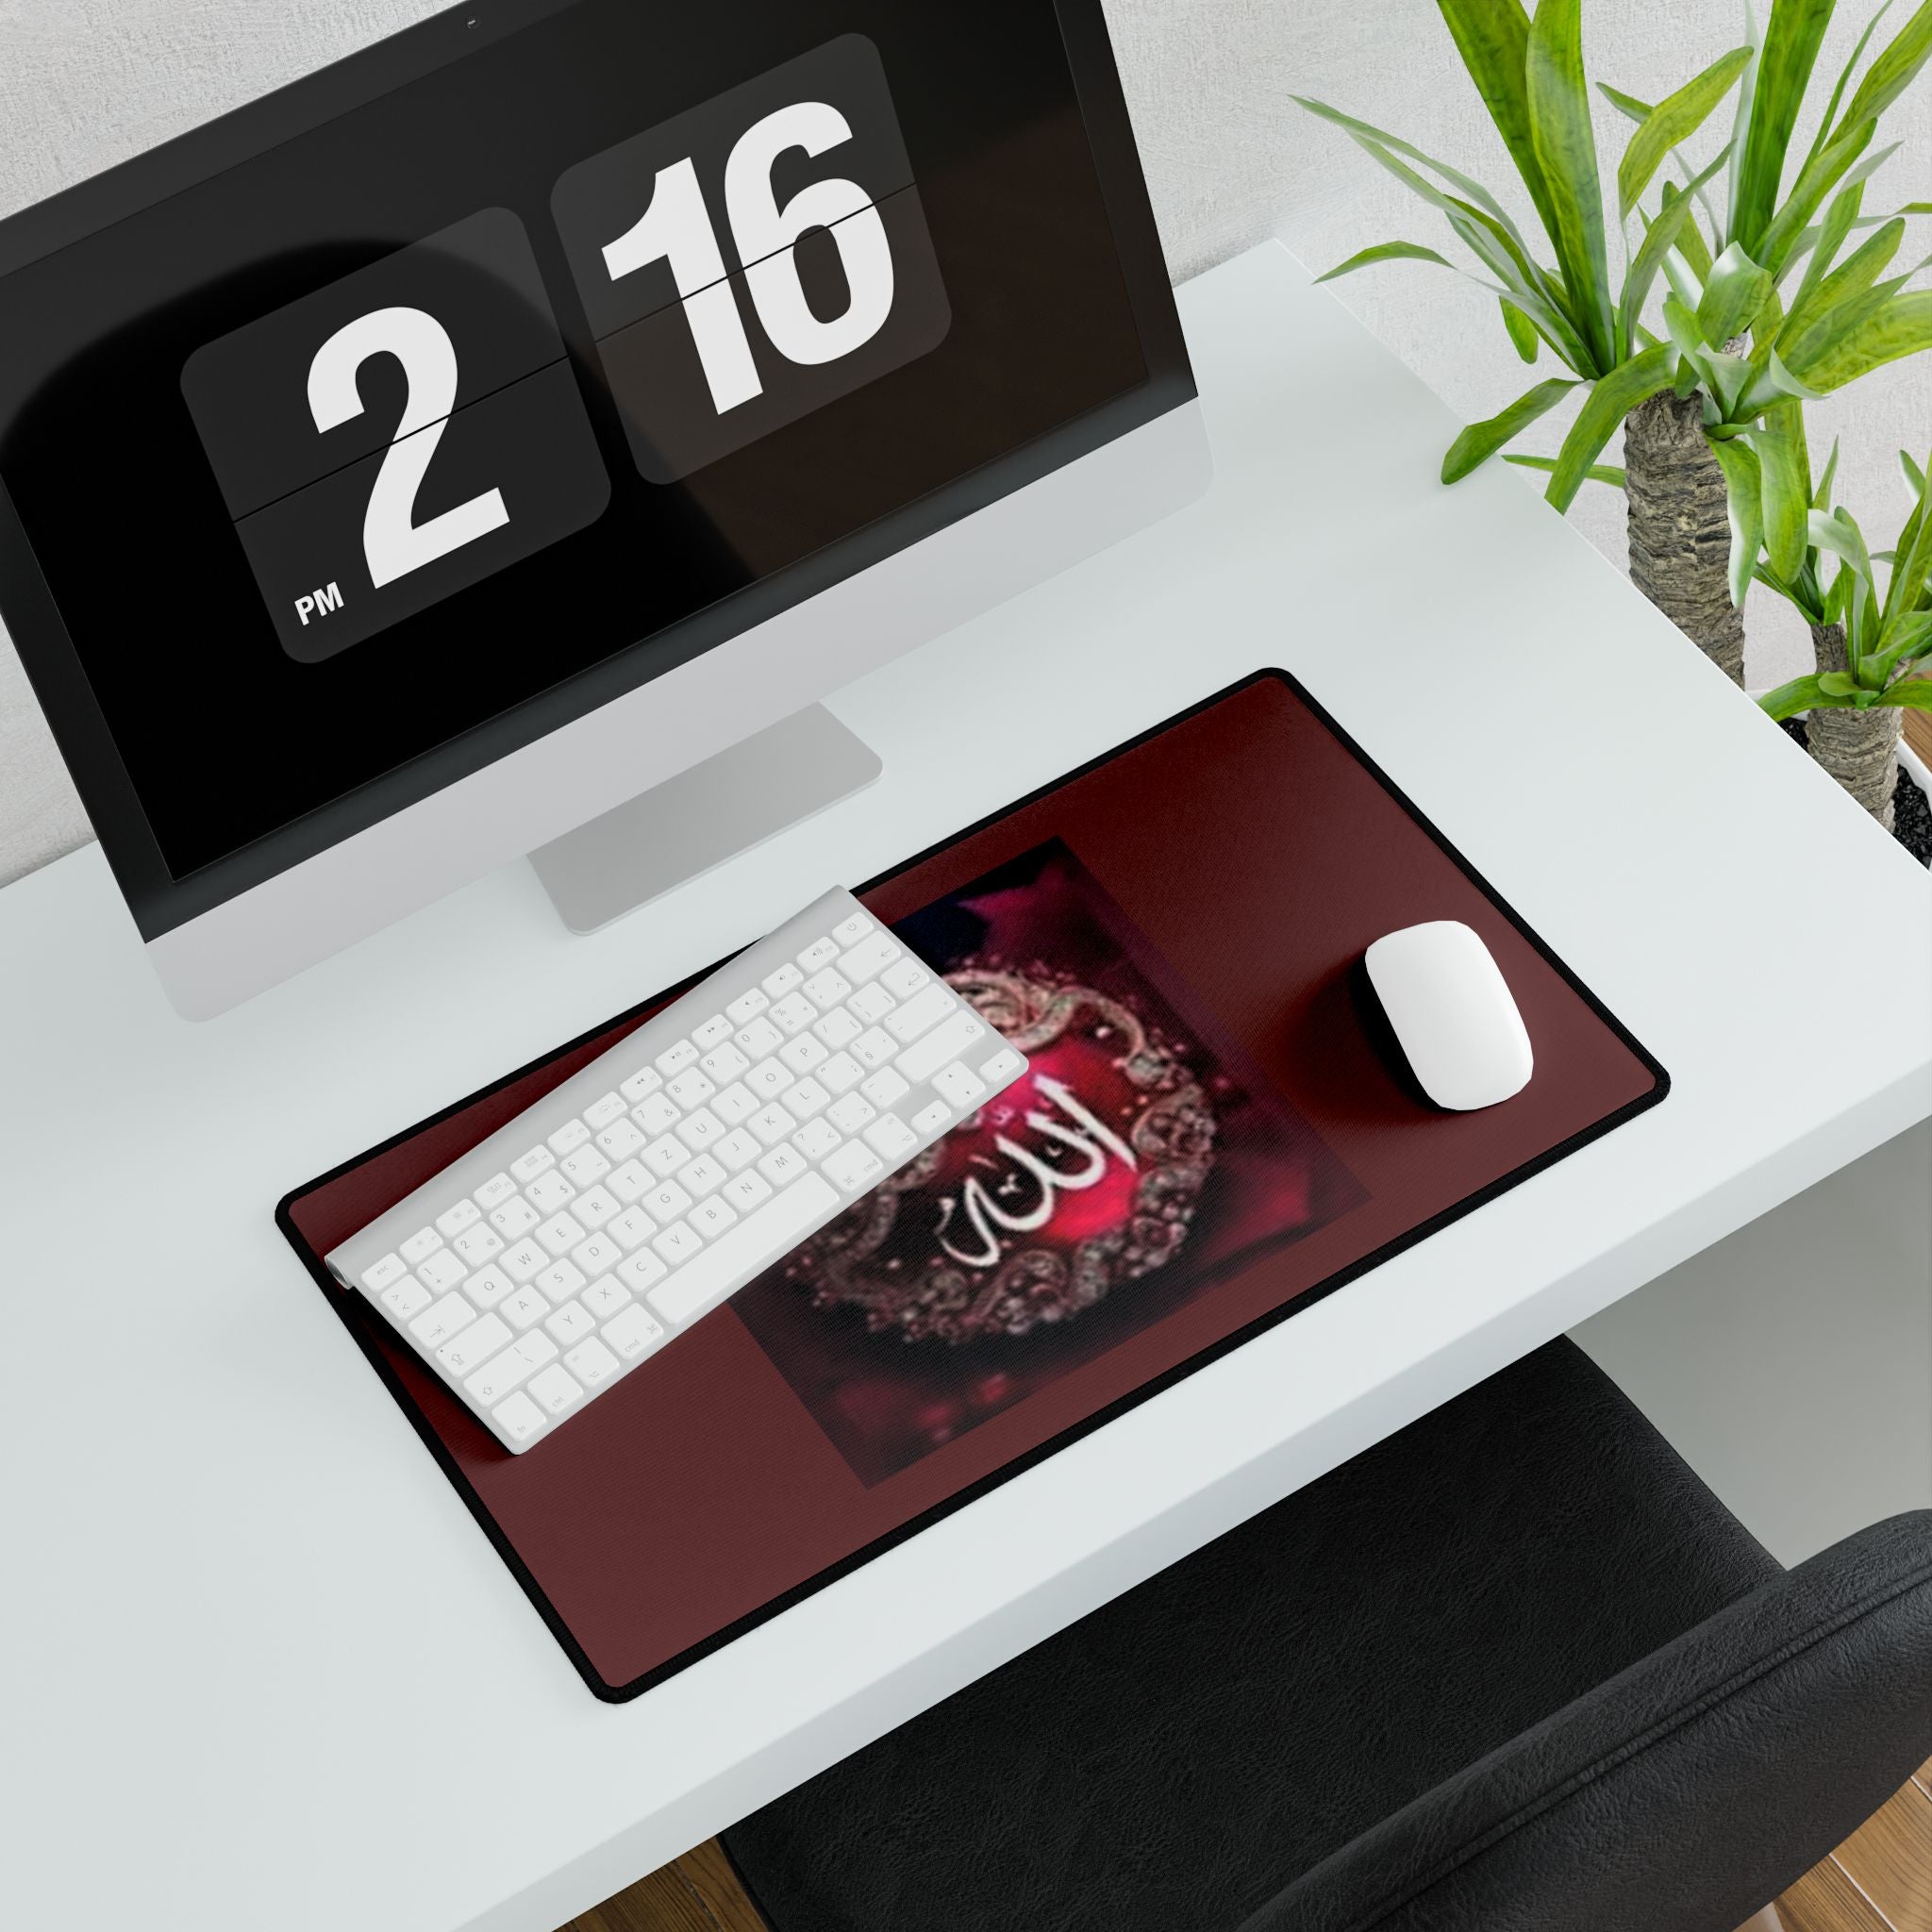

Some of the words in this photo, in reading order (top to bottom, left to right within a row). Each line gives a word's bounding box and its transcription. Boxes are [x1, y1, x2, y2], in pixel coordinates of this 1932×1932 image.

[308, 308, 509, 589] 2
[602, 102, 893, 415] 16
[294, 582, 343, 626] PM
[799, 1047, 808, 1058] P
[707, 1059, 715, 1068] 9
[672, 1085, 681, 1093] 8
[799, 1091, 810, 1101] L
[636, 1109, 645, 1119] 7
[763, 1115, 776, 1126] K
[695, 1123, 708, 1135] U
[604, 1136, 611, 1144] 6
[731, 1141, 741, 1152] J
[660, 1149, 673, 1160] Z
[568, 1161, 577, 1171] 5
[774, 1156, 790, 1169] M
[693, 1167, 707, 1178] H
[625, 1174, 637, 1185] T
[533, 1187, 541, 1196] 4
[741, 1182, 753, 1194] N
[659, 1193, 671, 1204] G
[591, 1201, 603, 1212] R
[496, 1214, 506, 1223] 3
[706, 1209, 717, 1220] B
[625, 1220, 634, 1230] F
[556, 1228, 567, 1238] E
[460, 1241, 471, 1250] 2
[670, 1235, 681, 1245] V
[588, 1246, 600, 1257] D
[517, 1252, 532, 1265] W
[635, 1261, 648, 1272] C
[553, 1273, 564, 1283] S
[483, 1281, 495, 1291] Q
[599, 1288, 612, 1300] X
[518, 1300, 529, 1310] A
[562, 1315, 573, 1324] Y
[625, 1339, 641, 1353] cmd
